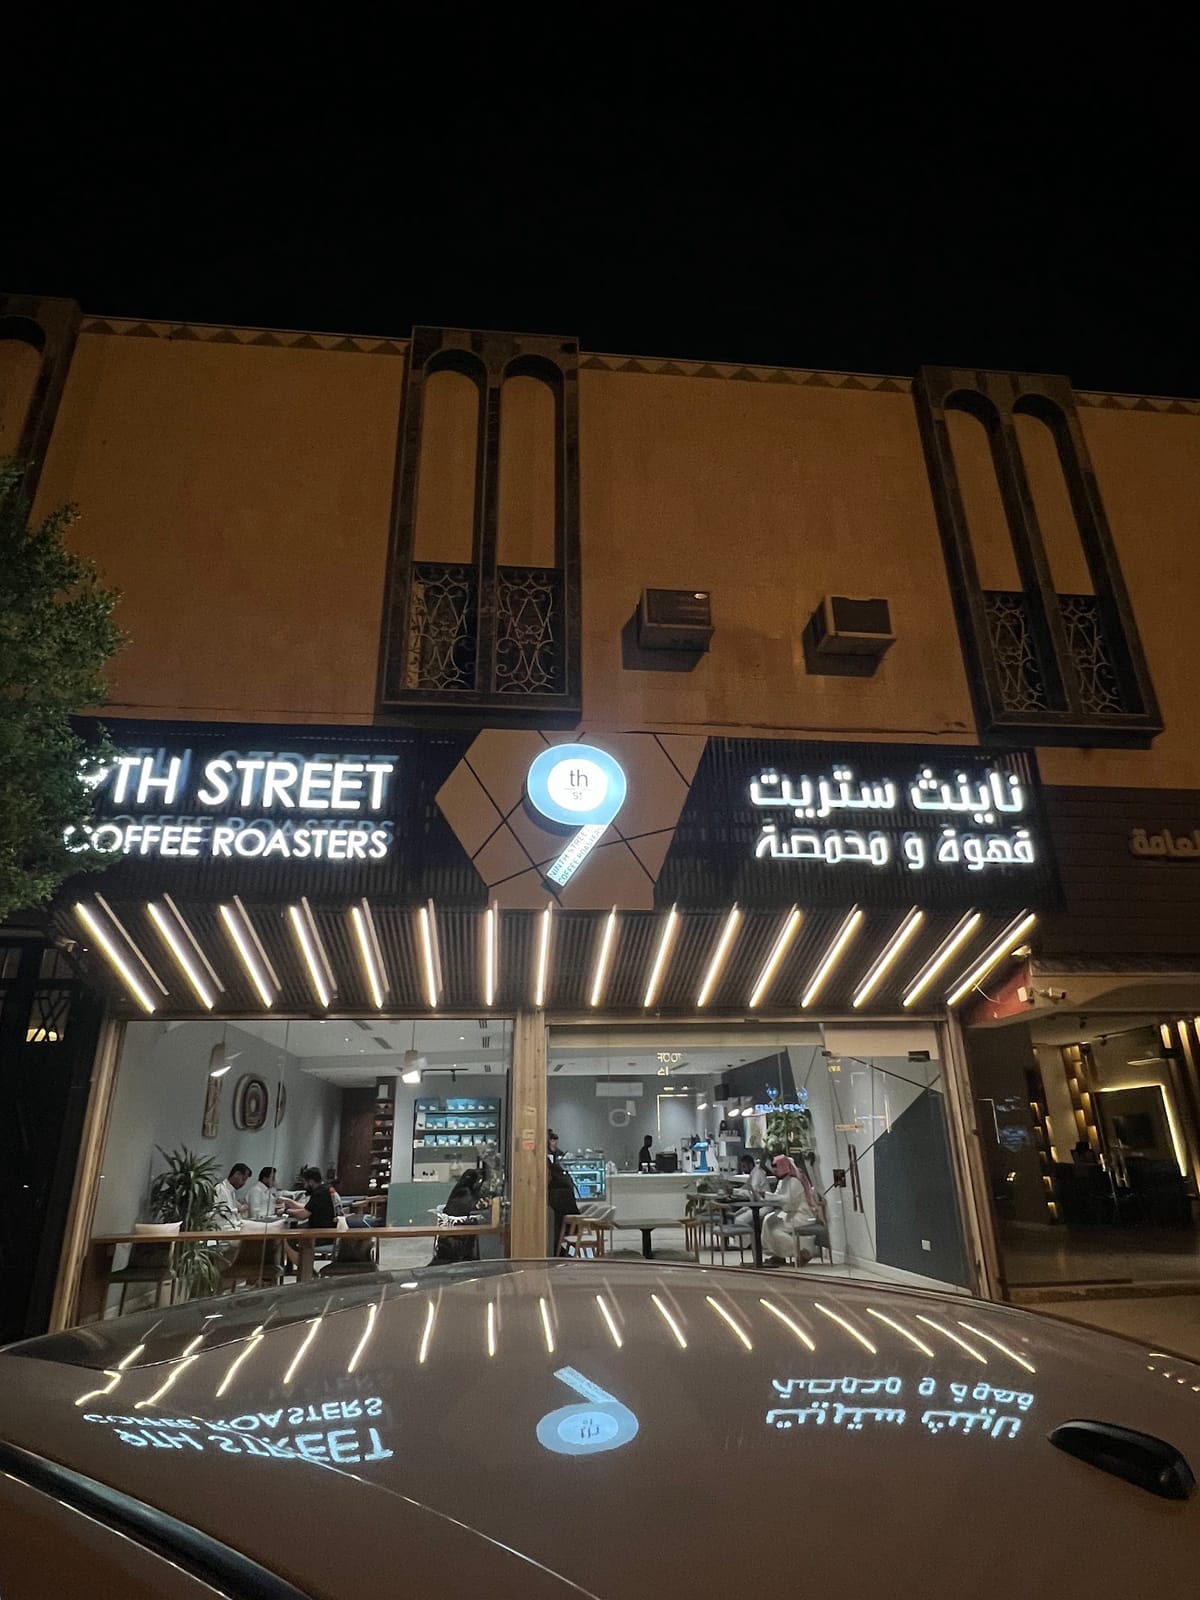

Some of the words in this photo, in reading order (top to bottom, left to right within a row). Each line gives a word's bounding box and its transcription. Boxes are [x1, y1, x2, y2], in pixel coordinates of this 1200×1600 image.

[197, 760, 394, 810] STREET
[569, 769, 589, 788] th
[749, 768, 896, 818] ستريت
[910, 768, 1024, 824] ناينث
[63, 824, 203, 856] COFFEE
[212, 826, 388, 859] ROASTERS
[549, 853, 570, 877] NINTH
[567, 826, 592, 853] STREE
[755, 822, 889, 866] محمصة
[904, 835, 925, 870] و
[938, 826, 1035, 871] قهوة
